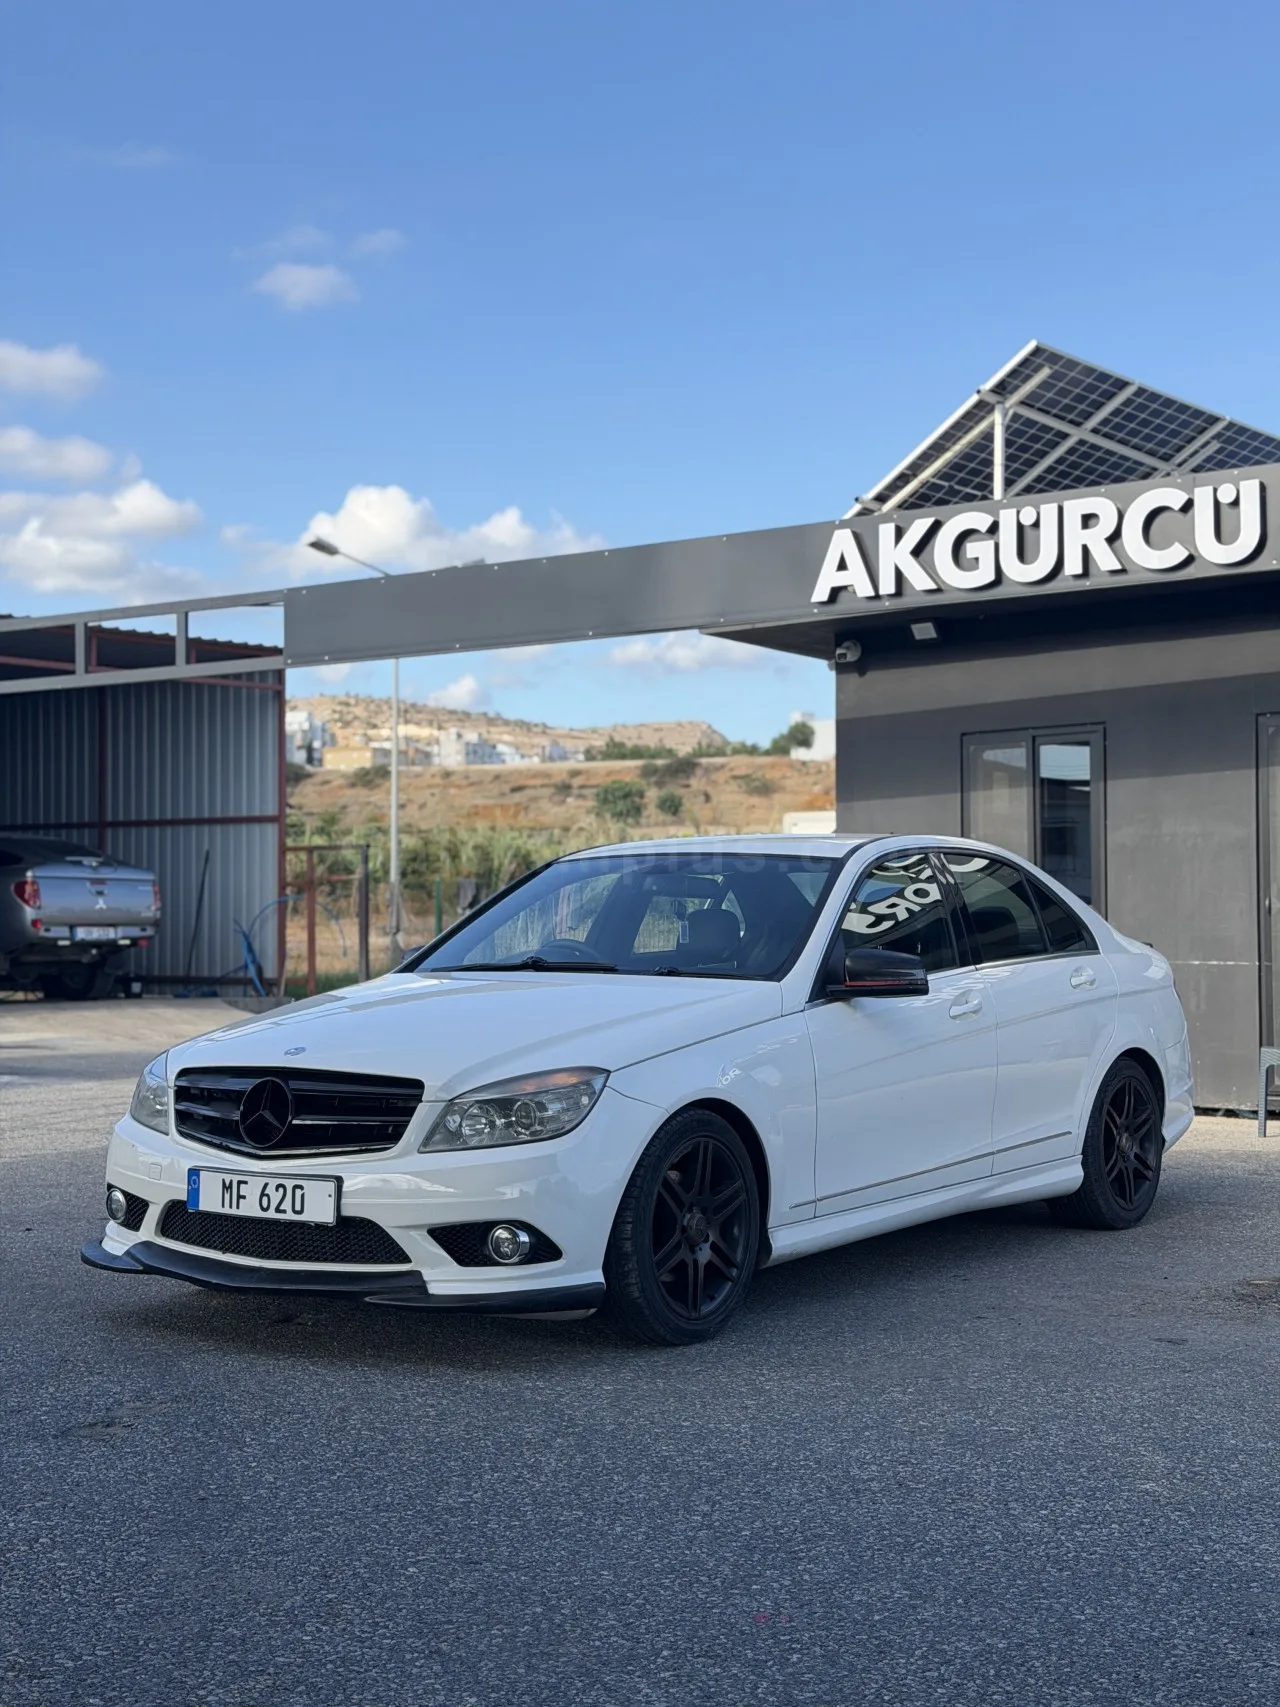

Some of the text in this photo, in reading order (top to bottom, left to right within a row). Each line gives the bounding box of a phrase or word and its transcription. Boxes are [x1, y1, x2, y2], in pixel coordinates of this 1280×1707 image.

[810, 478, 1262, 603] AKGÜRCÜ
[221, 1177, 306, 1216] MF 620
